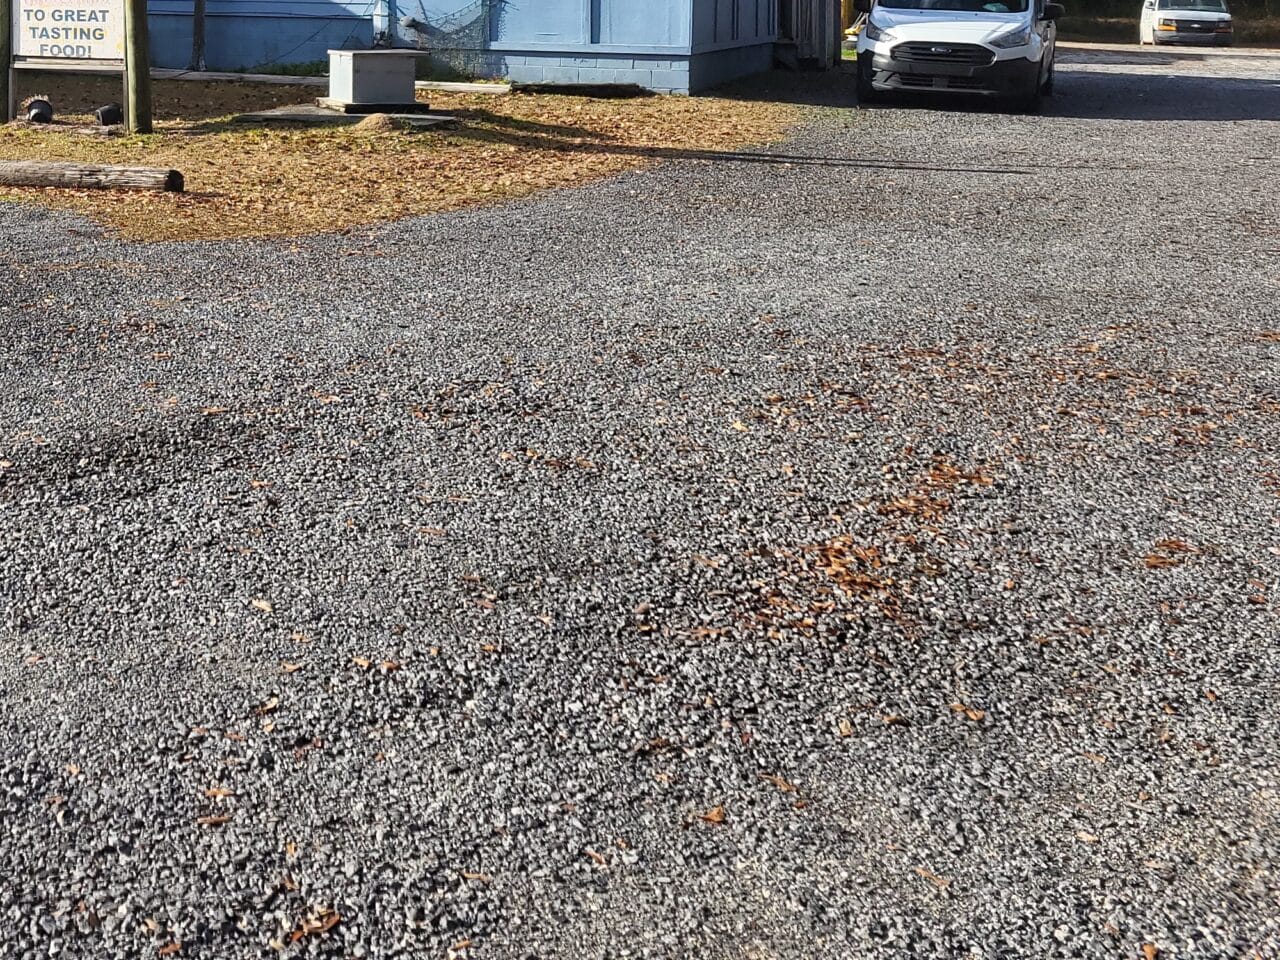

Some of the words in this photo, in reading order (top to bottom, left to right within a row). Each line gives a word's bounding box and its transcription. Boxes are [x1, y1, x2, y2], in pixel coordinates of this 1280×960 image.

[24, 9, 46, 21] TO
[51, 9, 109, 22] GREAT
[29, 26, 105, 40] TASTING
[40, 44, 92, 58] FOOD!
